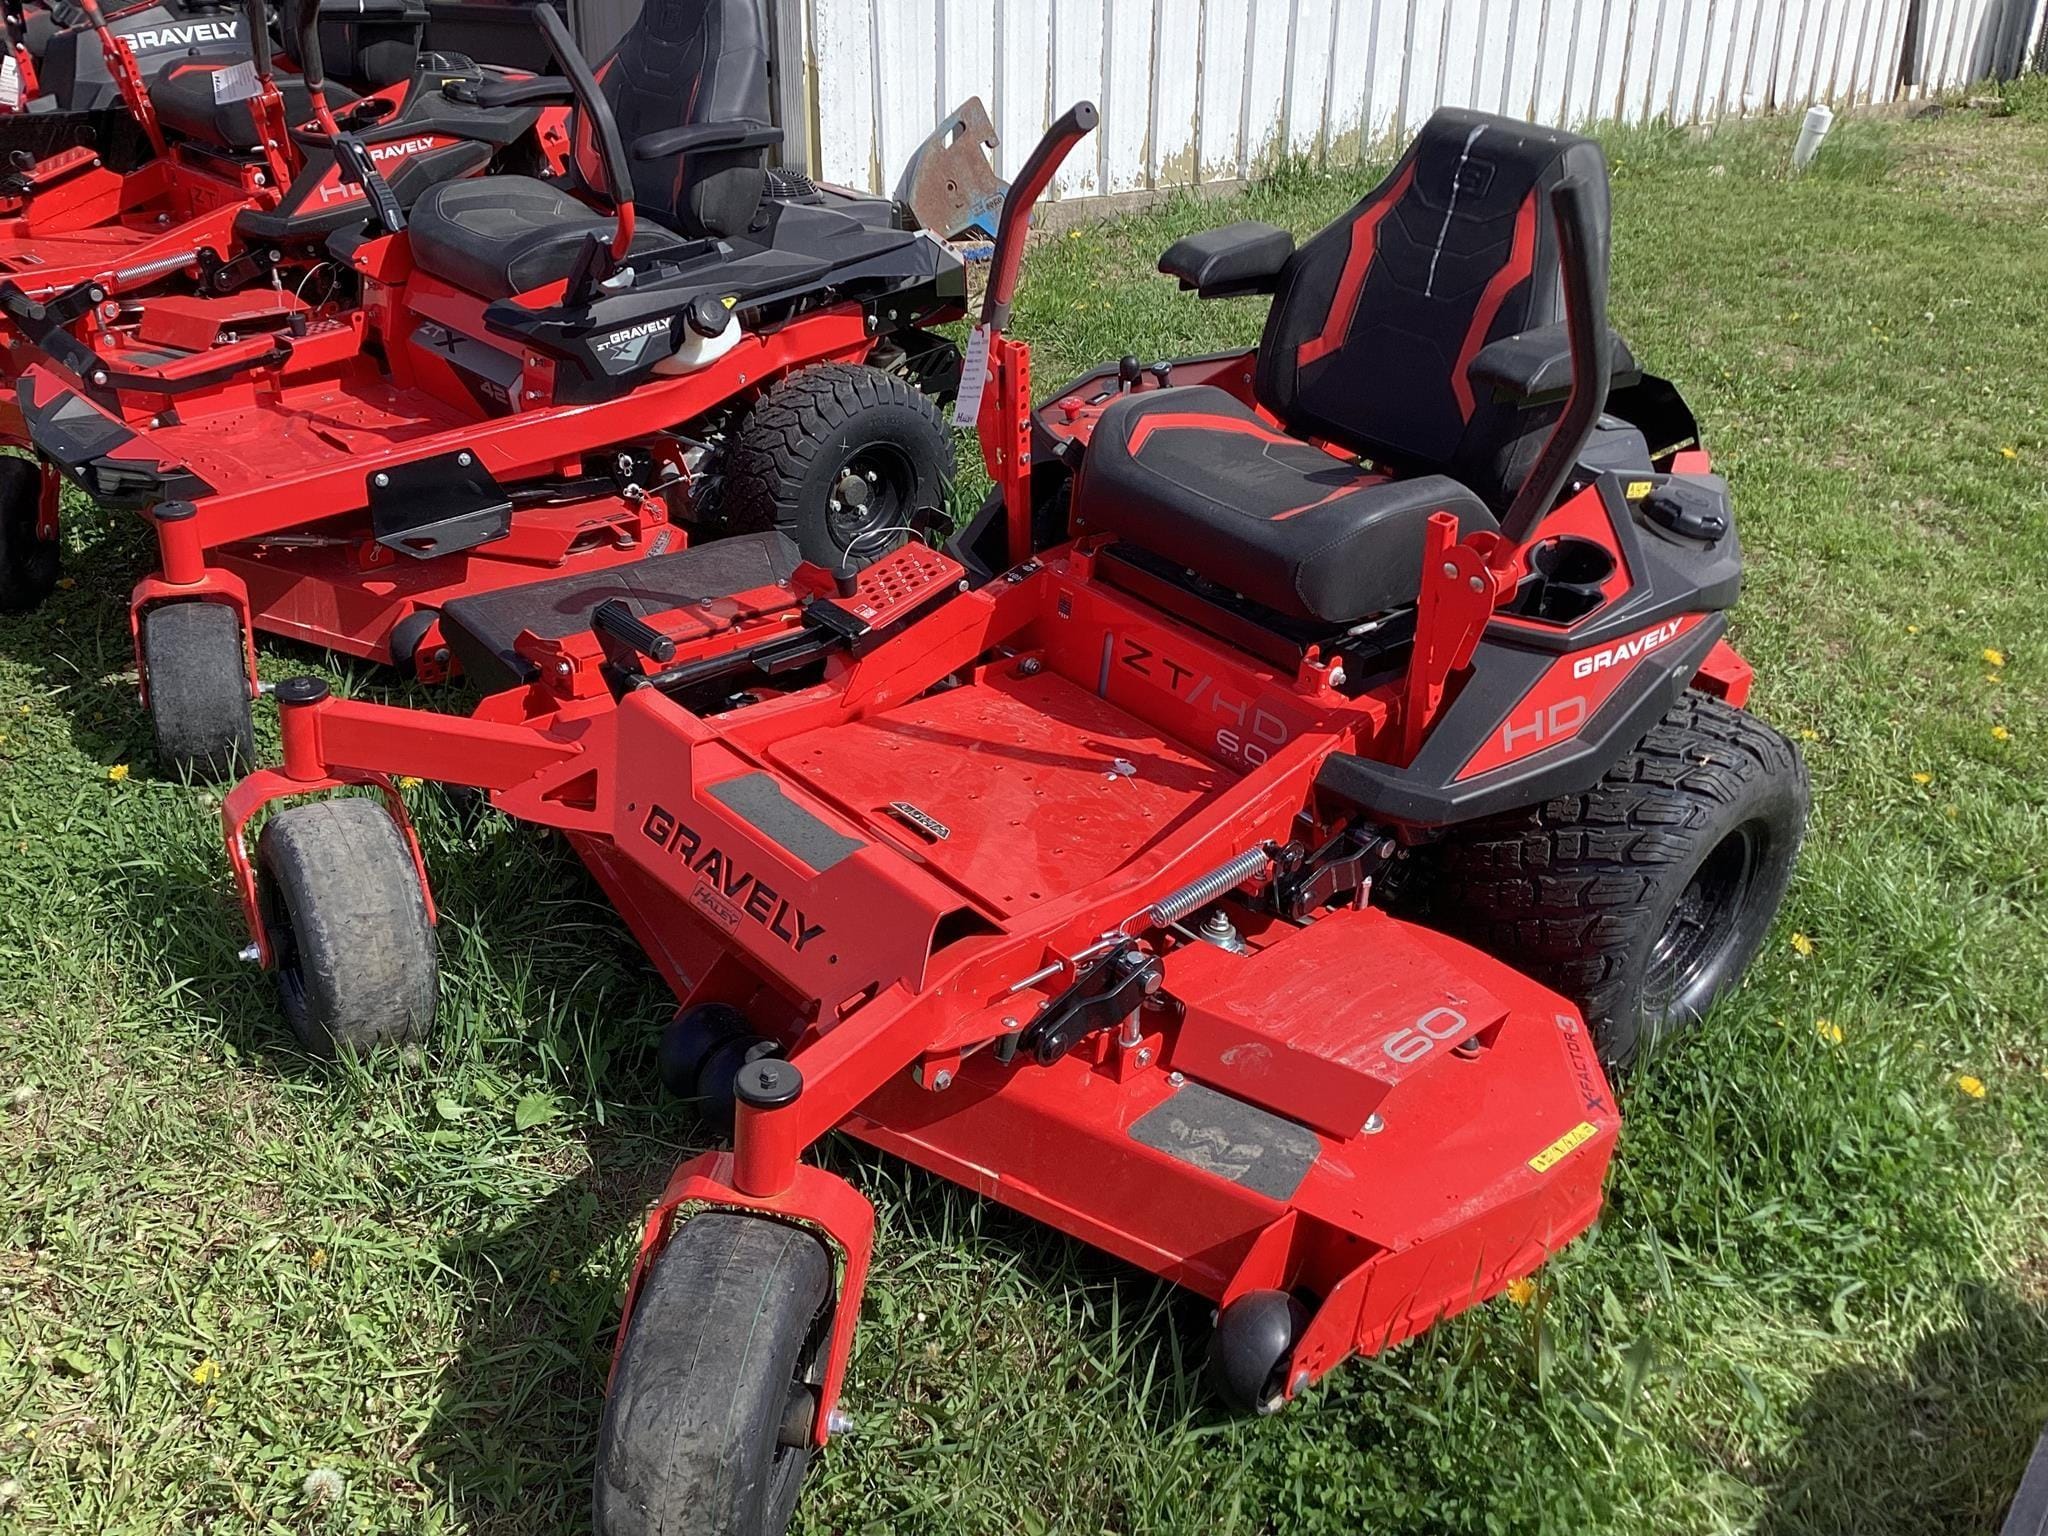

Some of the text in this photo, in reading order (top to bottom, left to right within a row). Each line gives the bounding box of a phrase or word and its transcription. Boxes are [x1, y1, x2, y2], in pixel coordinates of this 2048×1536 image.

[116, 21, 238, 52] GRAVELY
[370, 137, 434, 161] RAVELY
[609, 317, 671, 344] GRAVELY
[480, 381, 509, 404] 42
[1573, 617, 1684, 680] GRAVELY
[1503, 696, 1587, 753] HD
[1216, 729, 1268, 766] 60
[641, 804, 826, 953] GRAVELY
[694, 886, 739, 926] HALEY
[1383, 1007, 1467, 1063] 60
